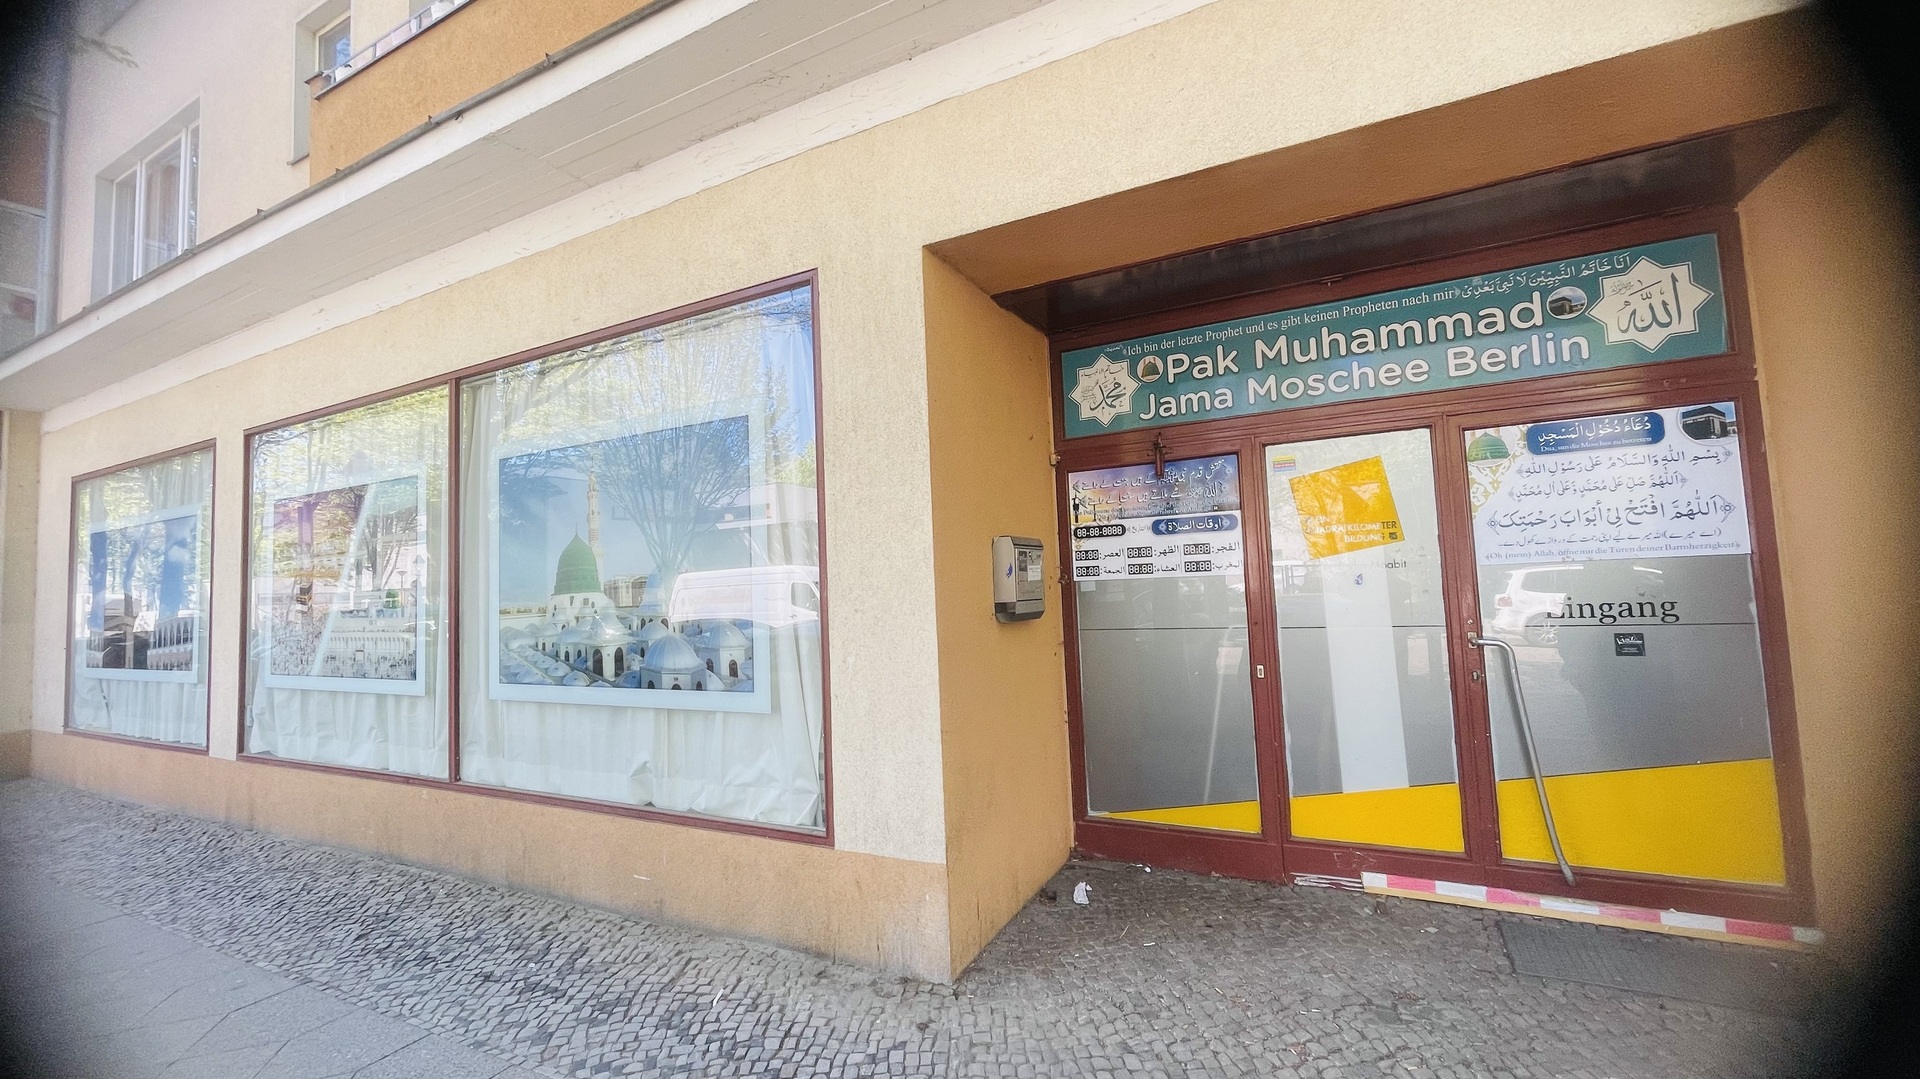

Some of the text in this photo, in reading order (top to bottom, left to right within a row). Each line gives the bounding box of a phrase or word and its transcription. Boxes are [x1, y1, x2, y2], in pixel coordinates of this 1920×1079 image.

[1128, 288, 1454, 355] Ich bin der letzte Prophet und es gibt keinen Propheten nach mir
[1167, 291, 1544, 383] Pak Muhammad
[1139, 387, 1233, 420] Jama
[1247, 358, 1430, 404] Moschee
[1447, 333, 1590, 377] Berlin
[1581, 440, 1610, 448] Moschee
[1076, 526, 1123, 538] 88-88-8888
[1344, 533, 1385, 543] BILDUNG
[1128, 547, 1152, 558] 88:88
[1184, 544, 1210, 555] 88:88
[1636, 544, 1663, 552] deiner
[1076, 551, 1099, 561] 88:88
[1076, 567, 1099, 577] 88:88
[1128, 564, 1152, 574] 88:88
[1185, 561, 1211, 572] 88:88
